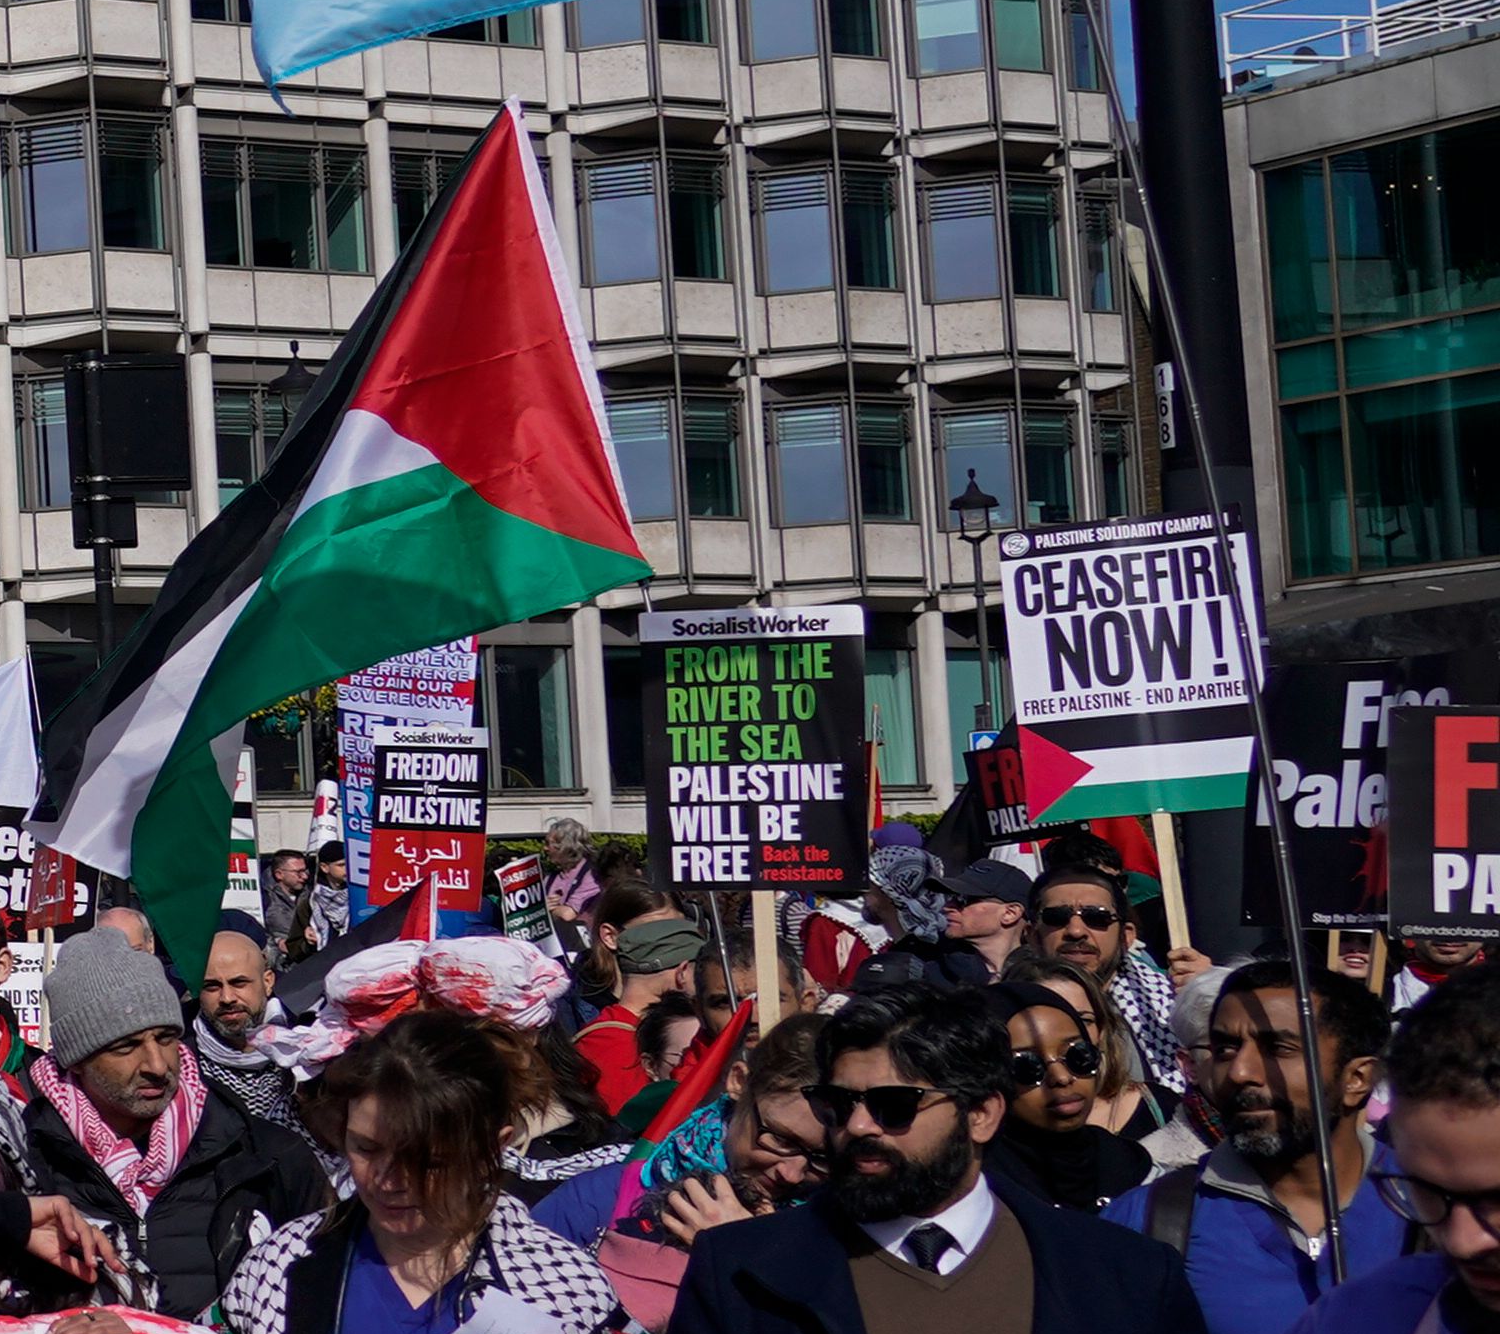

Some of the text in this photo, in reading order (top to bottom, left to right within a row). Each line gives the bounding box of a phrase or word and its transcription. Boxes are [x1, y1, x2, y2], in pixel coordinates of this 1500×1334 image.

[1034, 520, 1164, 551] PALESTINE SOLIDARITY
[1013, 536, 1237, 618] CEASEFIRE
[664, 642, 833, 683] FROM THE
[416, 678, 455, 694] OUR
[1023, 687, 1174, 717] FREE PALESTINE END
[666, 683, 816, 723] RIVER TO
[666, 723, 803, 763] THE SEA
[385, 752, 478, 783] FREEDOM
[668, 763, 844, 803] PALESTINE
[423, 780, 439, 795] for
[378, 794, 482, 827] PALESTINE
[668, 804, 802, 843] WILL BE
[393, 839, 462, 866] الحرية
[671, 845, 830, 882] FREE Back the
[762, 864, 844, 882] resistance
[504, 882, 542, 914] NOW
